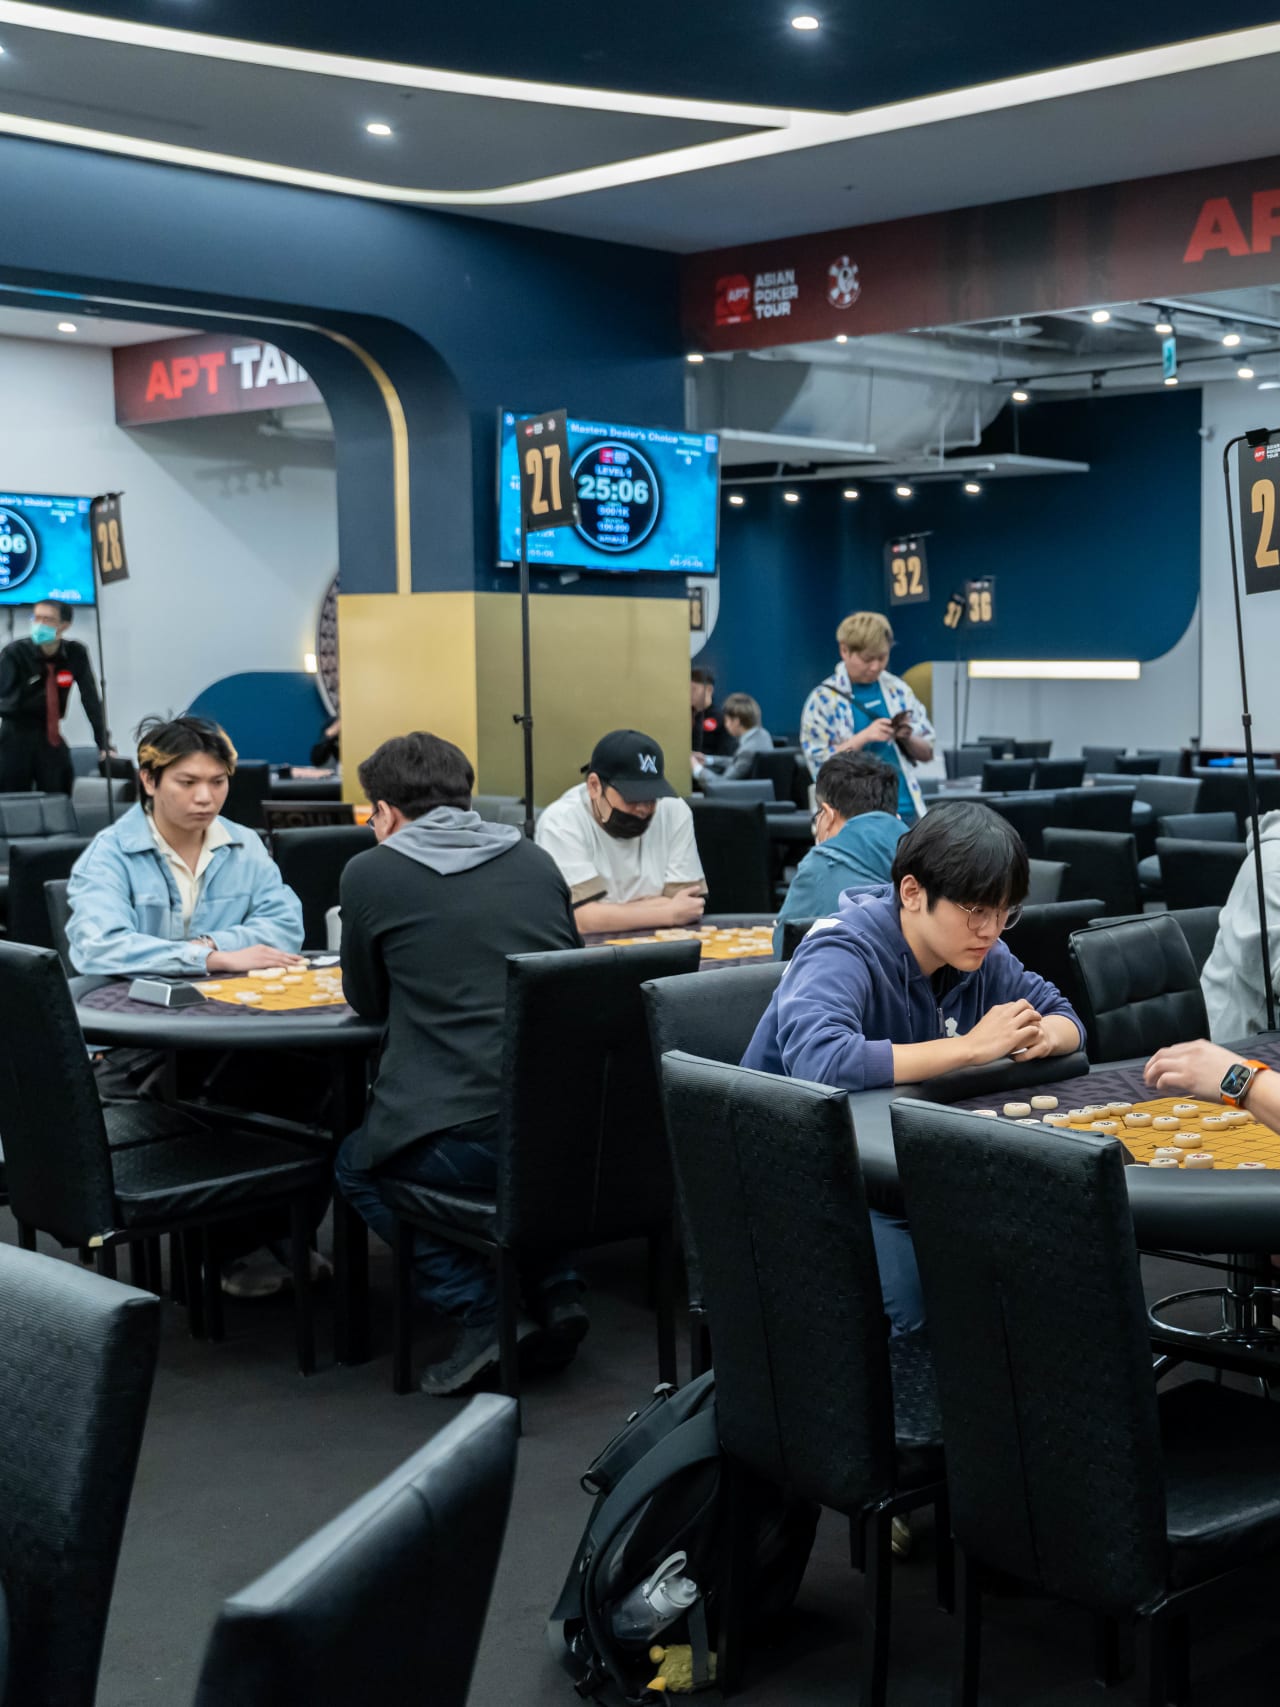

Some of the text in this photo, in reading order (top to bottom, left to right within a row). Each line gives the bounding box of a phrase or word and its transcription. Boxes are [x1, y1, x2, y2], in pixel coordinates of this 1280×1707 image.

[754, 269, 795, 288] ASIAN
[727, 287, 750, 303] APT
[754, 284, 798, 304] POKER
[754, 301, 791, 319] TOUR
[146, 344, 308, 402] APT TAI
[525, 444, 562, 515] 27
[596, 465, 625, 477] LEVEL
[578, 476, 648, 504] 25:06
[97, 520, 122, 572] 28
[892, 556, 924, 597] 32
